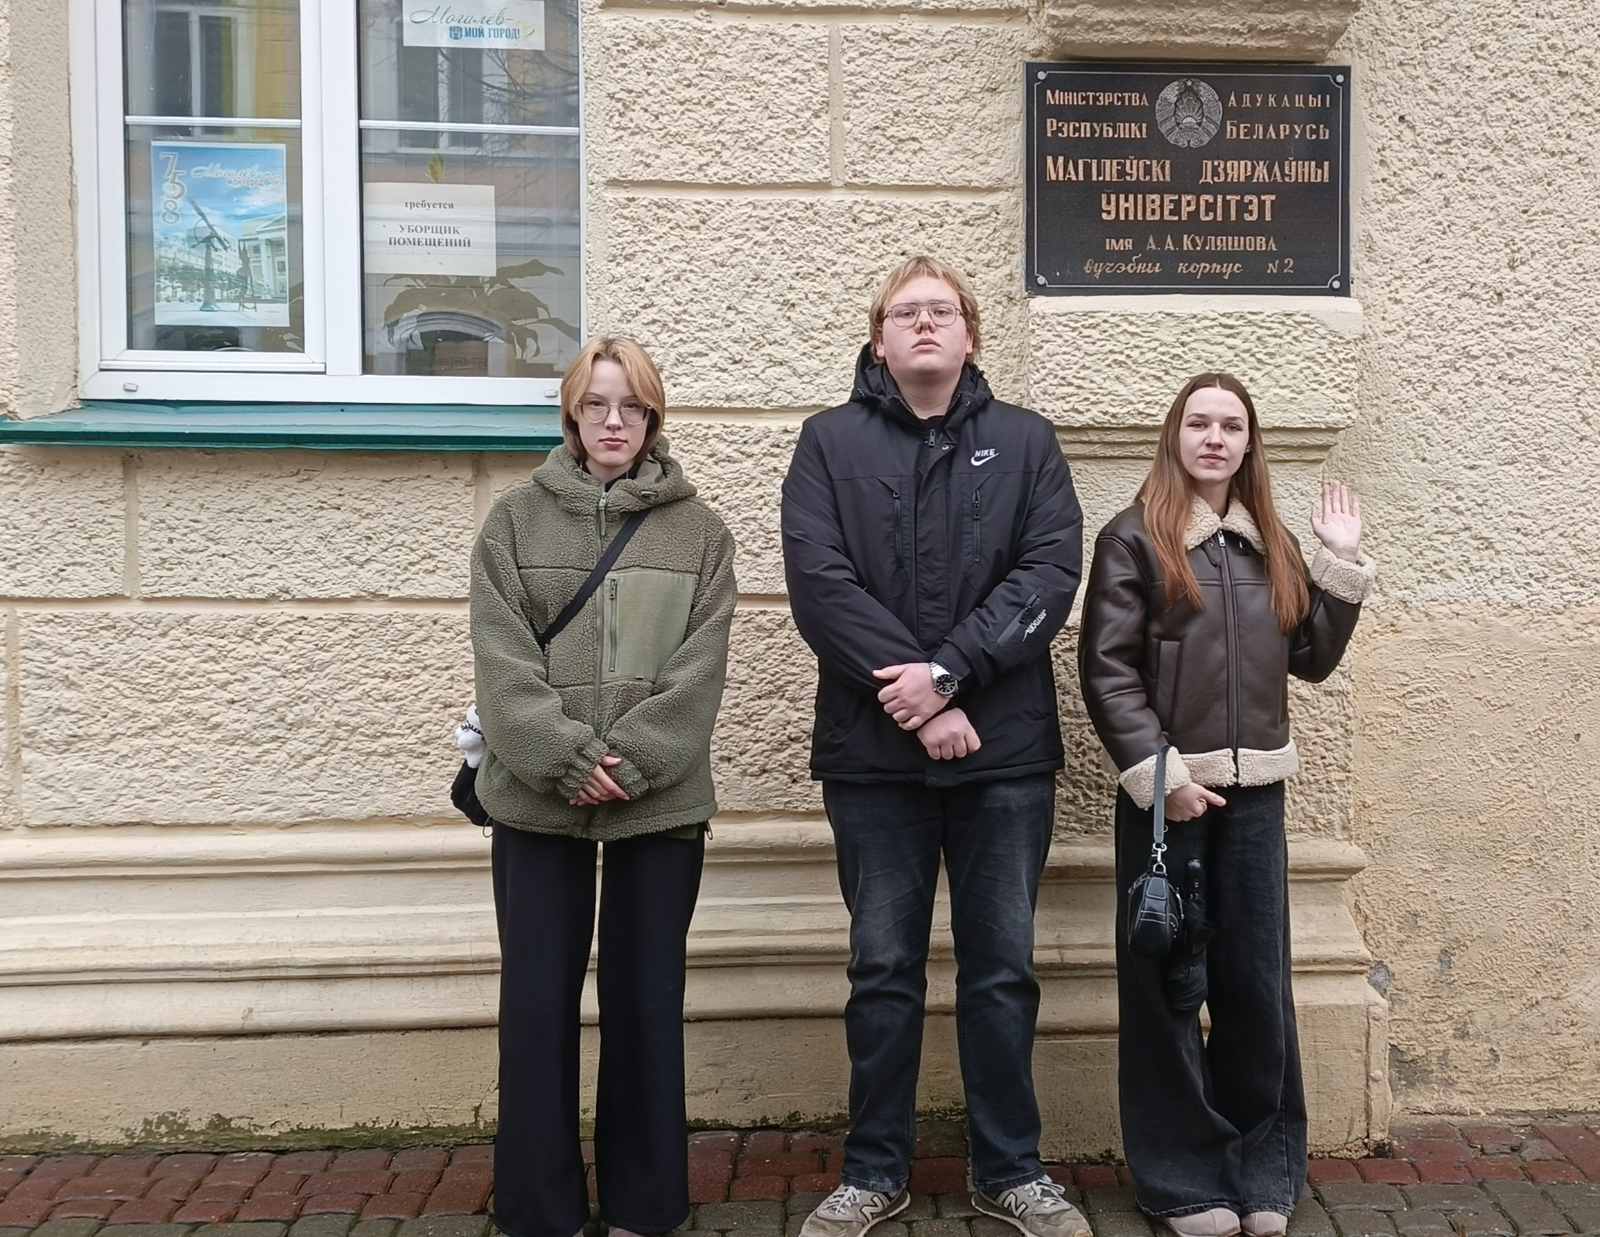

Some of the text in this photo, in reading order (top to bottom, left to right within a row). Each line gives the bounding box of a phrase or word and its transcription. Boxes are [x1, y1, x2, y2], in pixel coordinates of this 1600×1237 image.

[463, 25, 520, 40] МОЙ ГОРОД!
[1045, 88, 1331, 109] МІНІСТЭРСТВА АДУКАЦЫІ
[1045, 118, 1330, 140] РЭСПУБЛІКІ БЕЛАРУСЬ
[1046, 154, 1330, 184] МАГІЛЕЎСКІ ДЗЯРЖАЎНЫ
[404, 200, 455, 211] требуется
[399, 224, 461, 235] УБОРЩИК
[388, 235, 472, 248] ПОМЕЩЕНИЙ
[1083, 253, 1163, 279] вучэбны
[1177, 259, 1244, 279] корпус
[975, 448, 996, 457] NIKE
